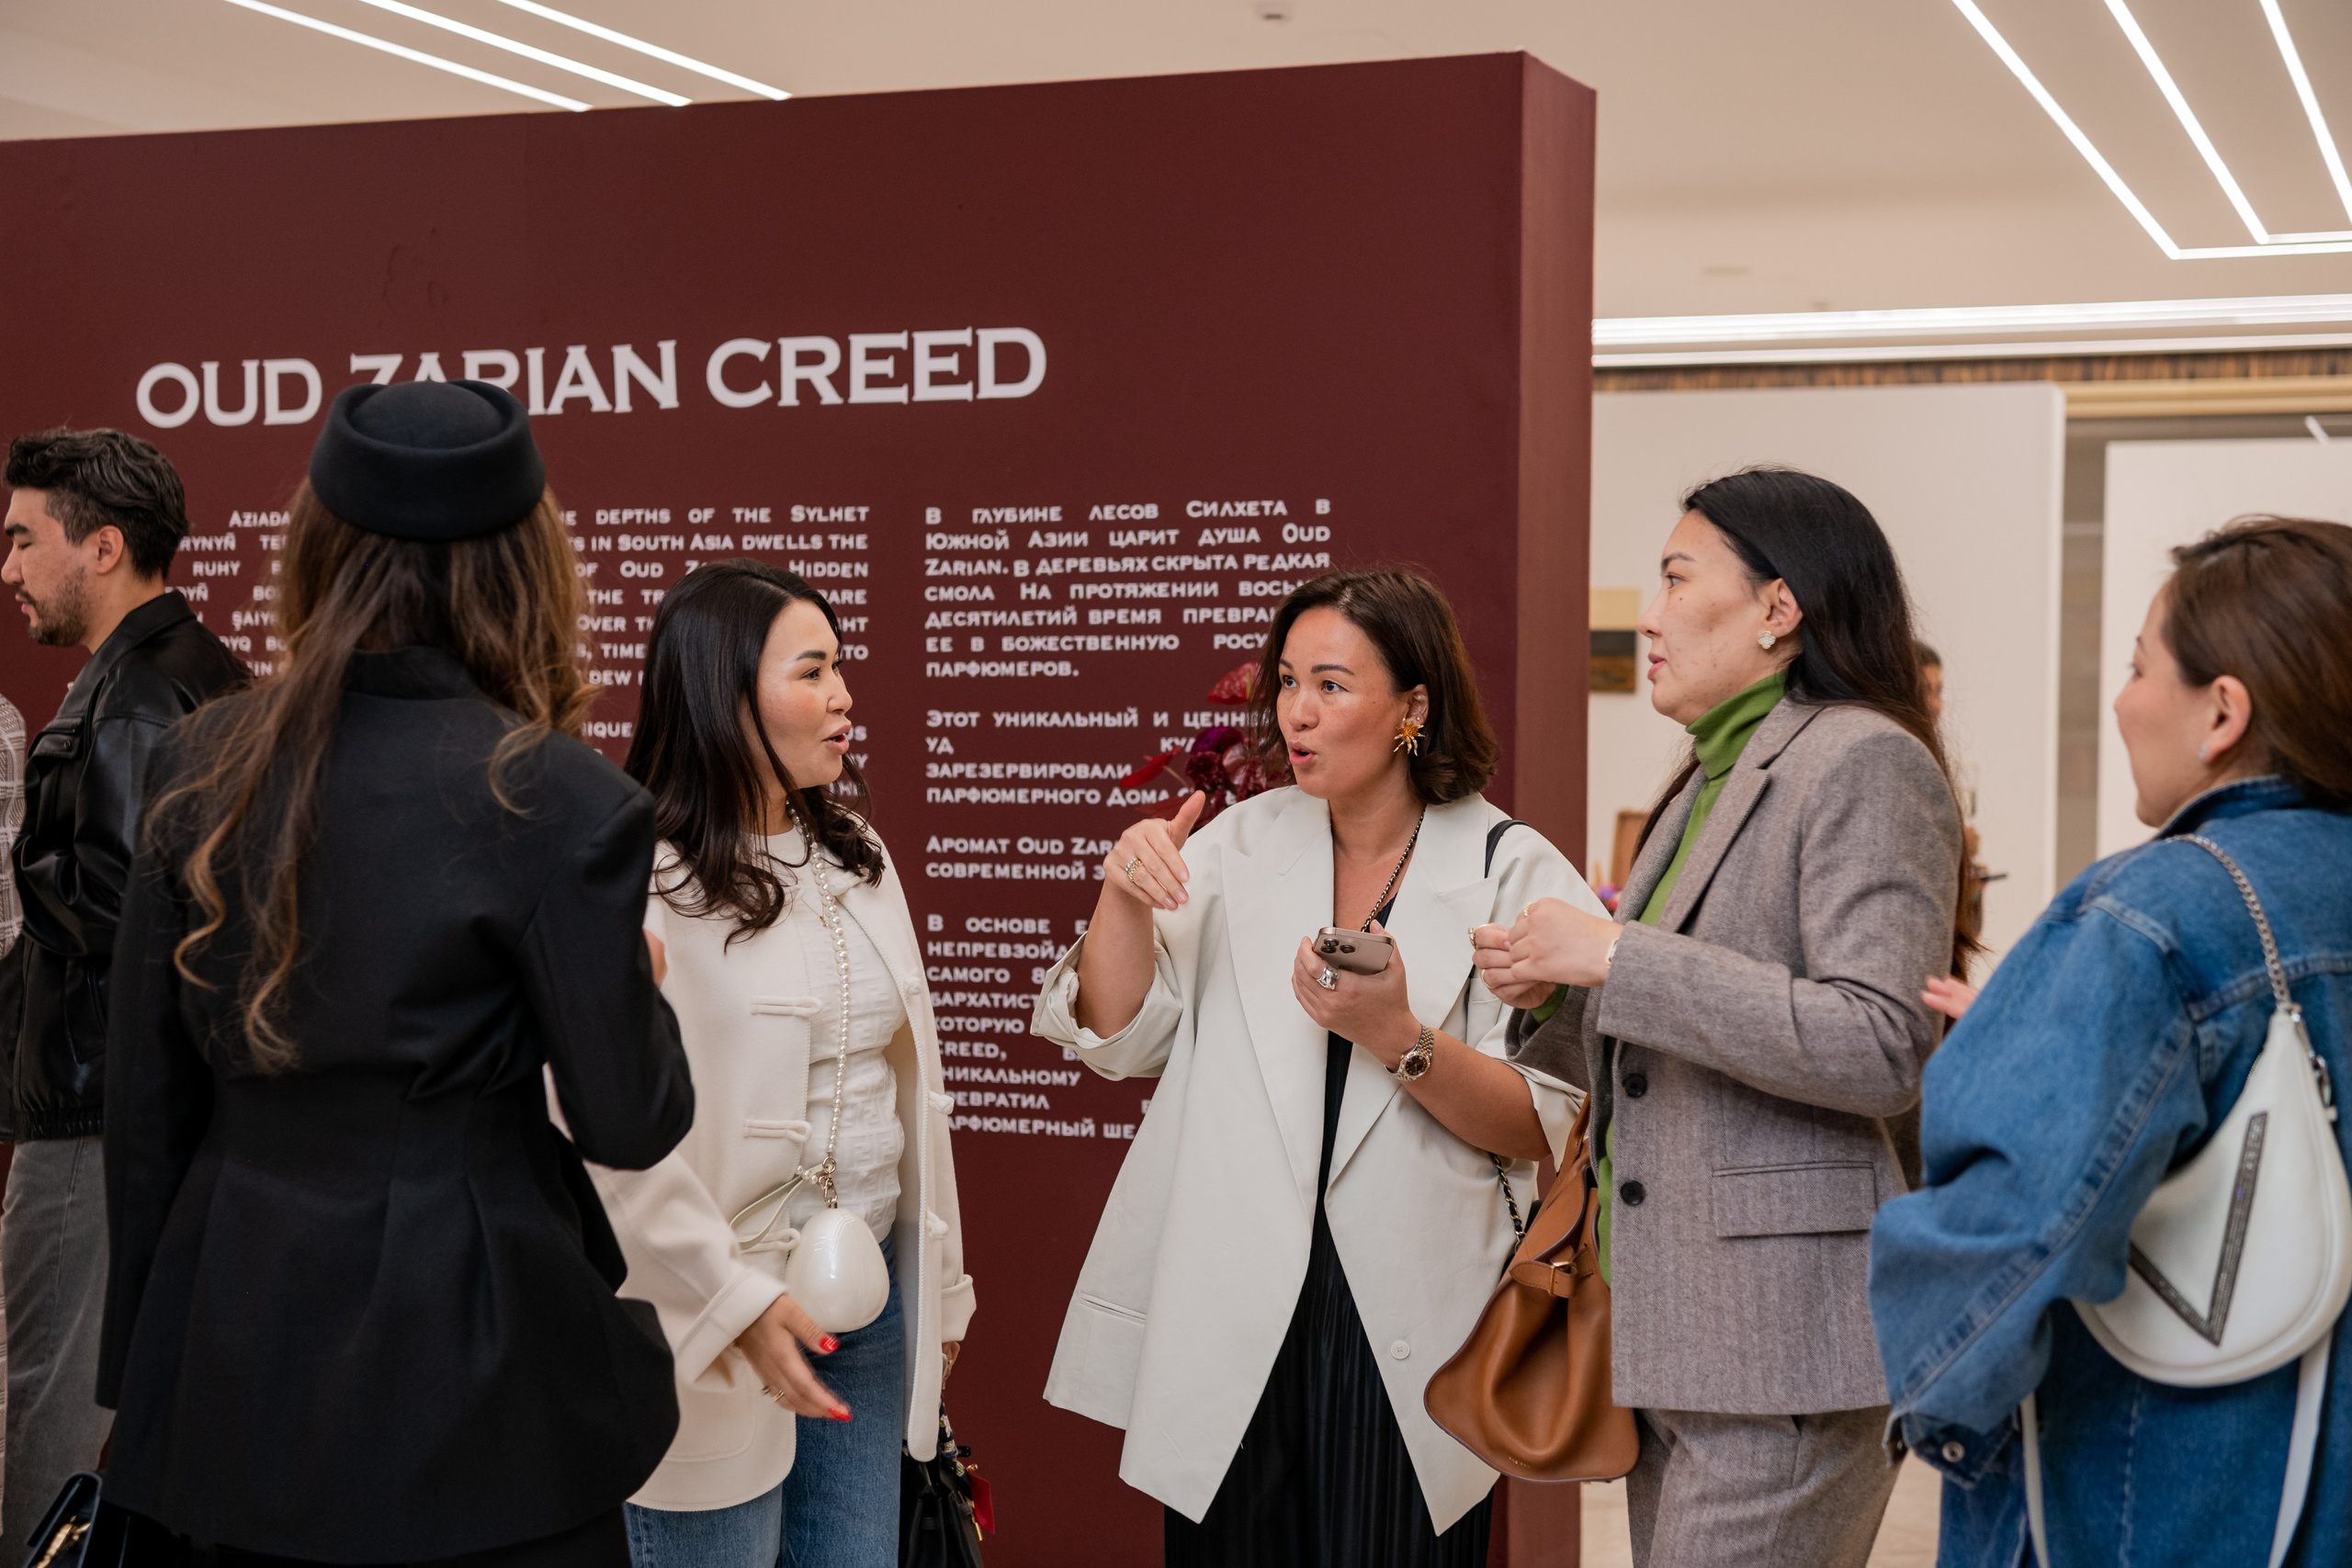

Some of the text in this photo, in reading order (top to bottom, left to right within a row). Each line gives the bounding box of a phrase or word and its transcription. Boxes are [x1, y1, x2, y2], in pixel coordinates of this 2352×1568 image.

[136, 356, 322, 429] OUD
[706, 326, 1047, 409] CREED
[595, 508, 671, 525] DEPTHS
[688, 508, 716, 524] OF
[732, 507, 771, 523] THE
[790, 504, 869, 523] SYLHET
[925, 498, 1330, 525] В ГЛУБИНЕ ЛЕСОВ СИЛХЕТА В
[591, 536, 612, 551] IN
[617, 534, 684, 551] SOUTH
[690, 533, 734, 550] ASIA
[742, 535, 822, 550] DWELLS
[828, 534, 868, 549] THE
[925, 523, 1330, 550] ЮЖНОЙ АЗИИ ЦАРИТ ДУША OUD
[192, 560, 241, 577] RUHY
[620, 559, 663, 578] OUD
[789, 558, 868, 578] HIDDEN
[924, 552, 1330, 578] ZARIAN. В ДЕРЕВЬЯХ СКРЫТА РЕДКАЯ
[587, 589, 624, 604] THE
[924, 585, 995, 602] СМОЛА
[1020, 582, 1052, 600] НА
[1069, 581, 1219, 600] ПРОТЯЖЕНИИ
[576, 614, 627, 632] OVER
[924, 605, 1079, 630] ДЕСЯТИЛЕТИЙ
[1088, 608, 1162, 626] ВРЕМЯ
[925, 636, 954, 653] ЕЕ
[970, 636, 985, 652] В
[1001, 634, 1180, 652] БОЖЕСТВЕННУЮ
[589, 670, 632, 686] DEW
[925, 660, 1080, 678] ПАРФЮМЕРОВ.
[925, 709, 980, 728] ЭТОТ
[992, 706, 1138, 728] УНИКАЛЬНЫЙ
[1153, 711, 1170, 728] И
[924, 736, 955, 755] УД
[925, 762, 1133, 779] ЗАРЕЗЕРВИРОВАЛИ
[925, 787, 1102, 805] ПАРФЮМЕРНОГО
[925, 835, 1119, 855] АРОМАТ OUD ZAR
[924, 860, 1086, 880] СОВРЕМЕННОЙ
[926, 913, 1051, 934] В ОСНОВЕ
[926, 966, 1011, 984] САМОГО
